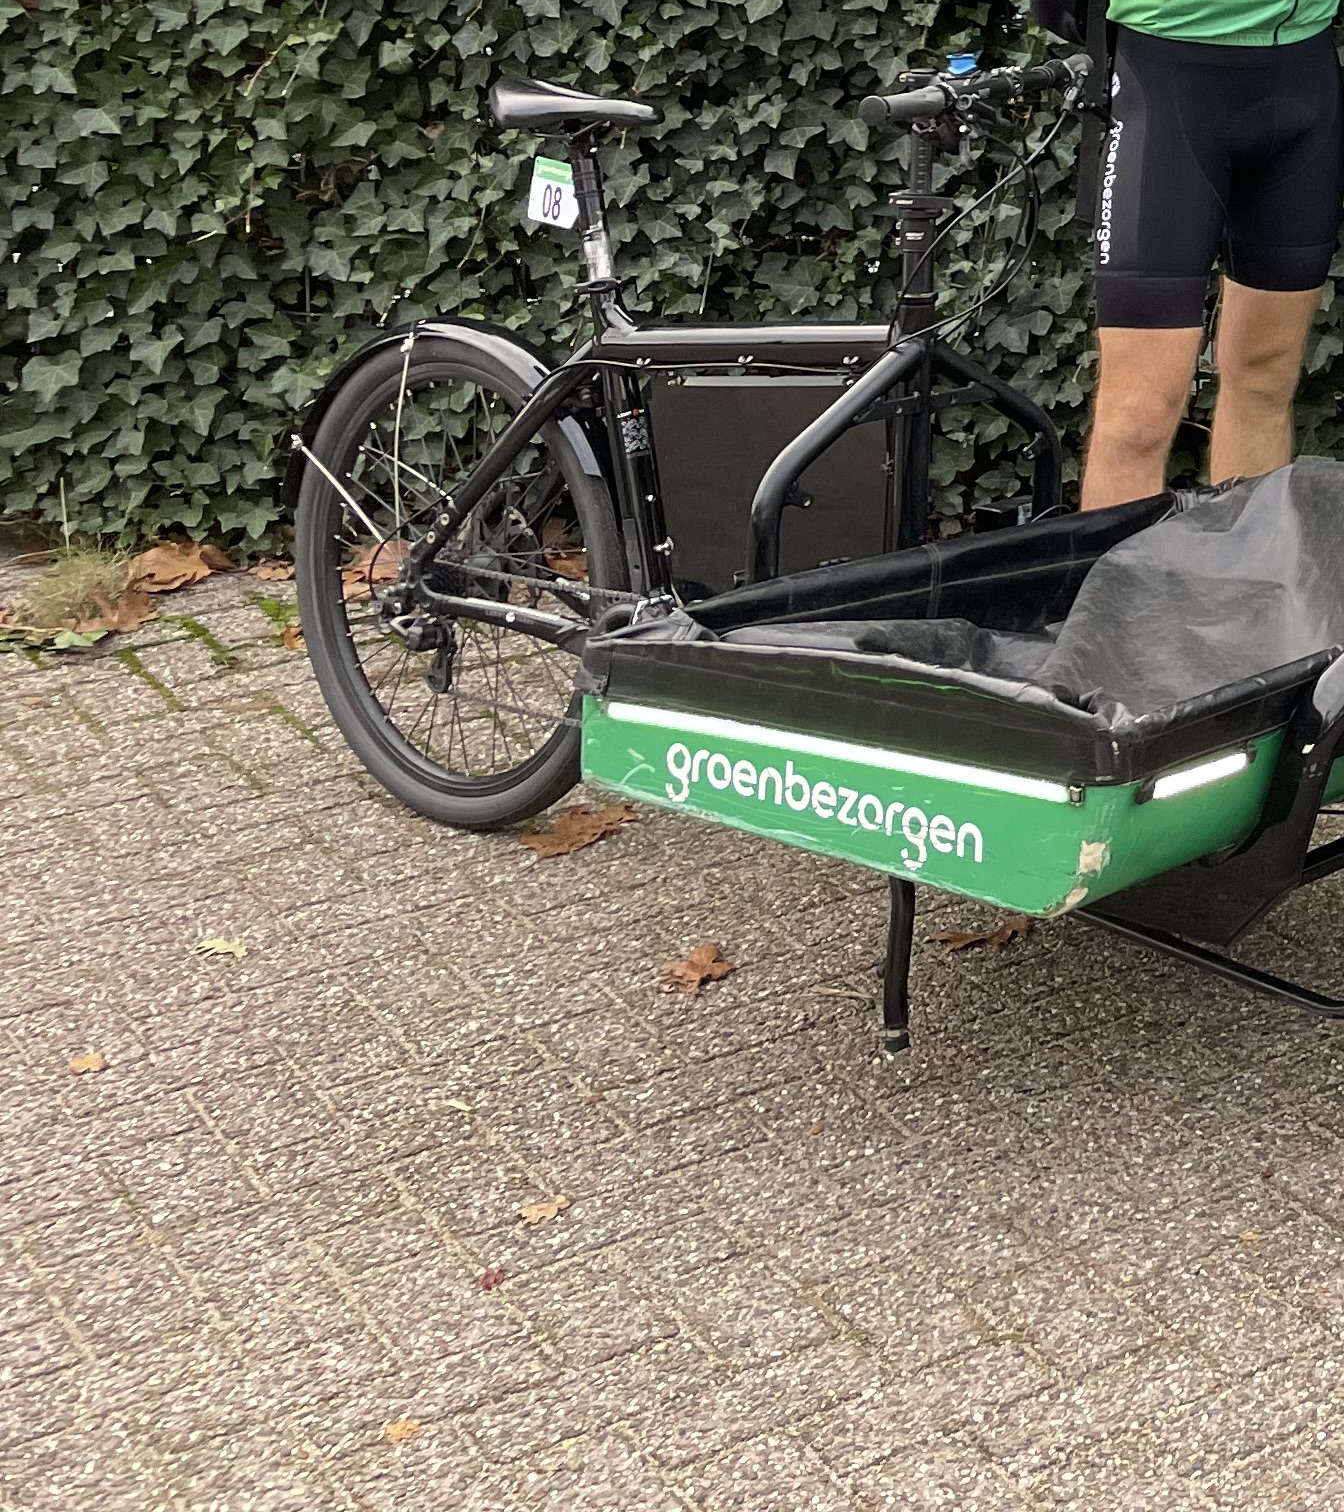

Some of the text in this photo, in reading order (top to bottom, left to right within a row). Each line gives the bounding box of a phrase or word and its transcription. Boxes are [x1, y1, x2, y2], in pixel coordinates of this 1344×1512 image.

[542, 183, 562, 221] 08
[1096, 121, 1123, 265] groenbezorgen
[665, 742, 984, 871] groenbezorgen
